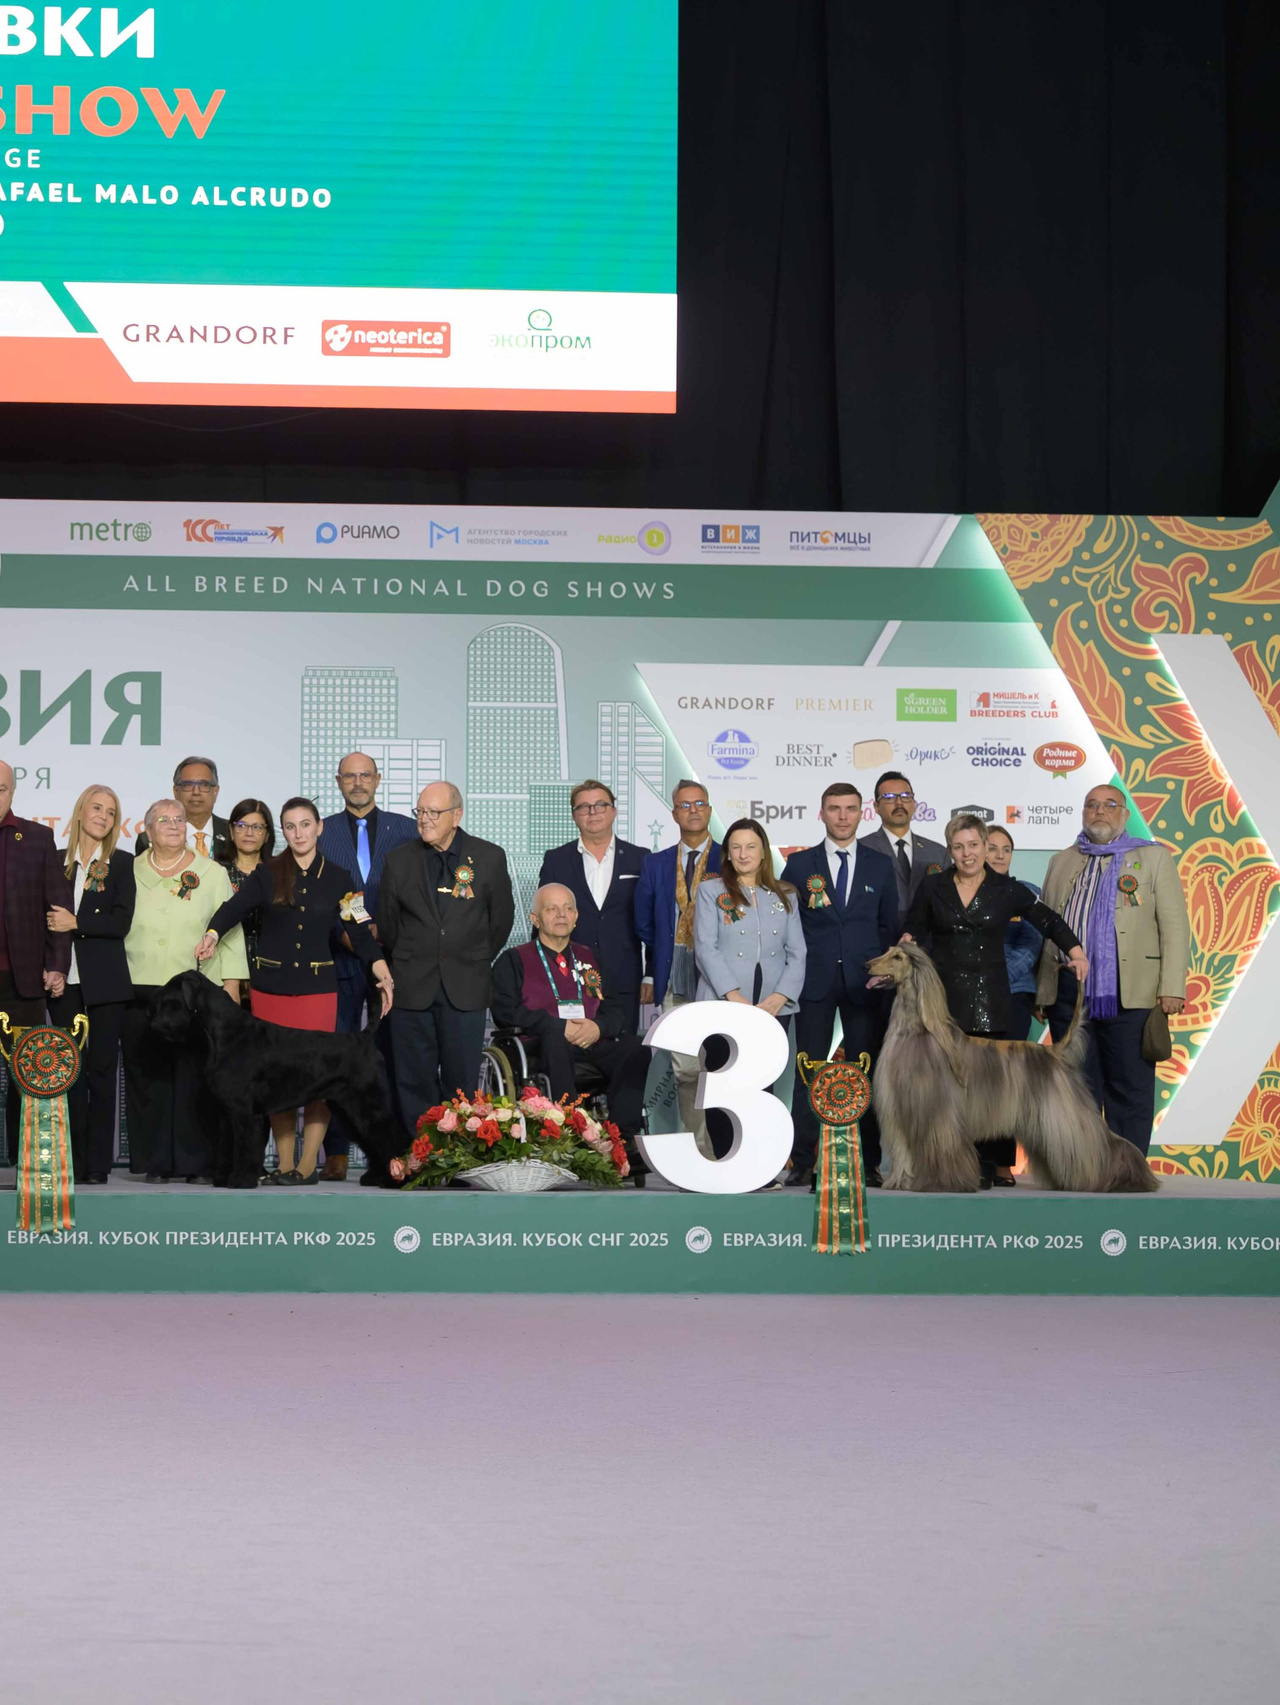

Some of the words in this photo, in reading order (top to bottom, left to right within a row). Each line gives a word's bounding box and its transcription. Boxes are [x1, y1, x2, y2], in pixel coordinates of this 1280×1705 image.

[96, 184, 178, 205] MALO
[192, 186, 331, 208] ALCRUDO
[123, 324, 295, 344] GRANDORF
[353, 328, 444, 346] neoterica
[467, 537, 512, 545] НОВОСТЕЙ
[124, 575, 175, 591] ALL
[195, 576, 287, 593] BREED
[308, 578, 467, 595] NATIONAL
[487, 580, 548, 597] DOG
[568, 581, 674, 599] SHOWS
[910, 697, 946, 705] GREEN
[992, 692, 1027, 700] МИШЕЛЬ
[678, 697, 774, 710] GRANDORF
[796, 698, 873, 711] PREMIER
[905, 706, 948, 714] HOLDER
[970, 710, 1026, 718] BREEDERS
[1031, 710, 1059, 718] CLUB
[711, 744, 755, 756] Farmina
[787, 744, 823, 754] BEST
[1042, 748, 1078, 759] Родные
[775, 756, 833, 767] DINNER
[1045, 758, 1076, 767] корма
[750, 801, 806, 823] Брит
[1027, 804, 1073, 815] четыре
[1027, 816, 1060, 824] лапы
[635, 1000, 795, 1193] 3
[7, 1231, 94, 1246] ЕВРАЗИЯ.
[100, 1232, 159, 1244] КУБОК
[166, 1232, 287, 1247] ПРЕЗИДЕНТА
[294, 1232, 330, 1245] РКФ
[336, 1232, 375, 1245] 2025
[433, 1233, 516, 1246] ЕВРАЗИЯ.
[523, 1233, 582, 1246] КУБОК
[589, 1233, 624, 1246] СНГ
[630, 1233, 668, 1246] 2025
[724, 1233, 806, 1246] ЕВРАЗИЯ.
[878, 1234, 997, 1250] ПРЕЗИДЕНТА
[1004, 1235, 1039, 1248] РКФ
[1045, 1235, 1083, 1248] 2025
[1140, 1236, 1221, 1249] ЕВРАЗИЯ.
